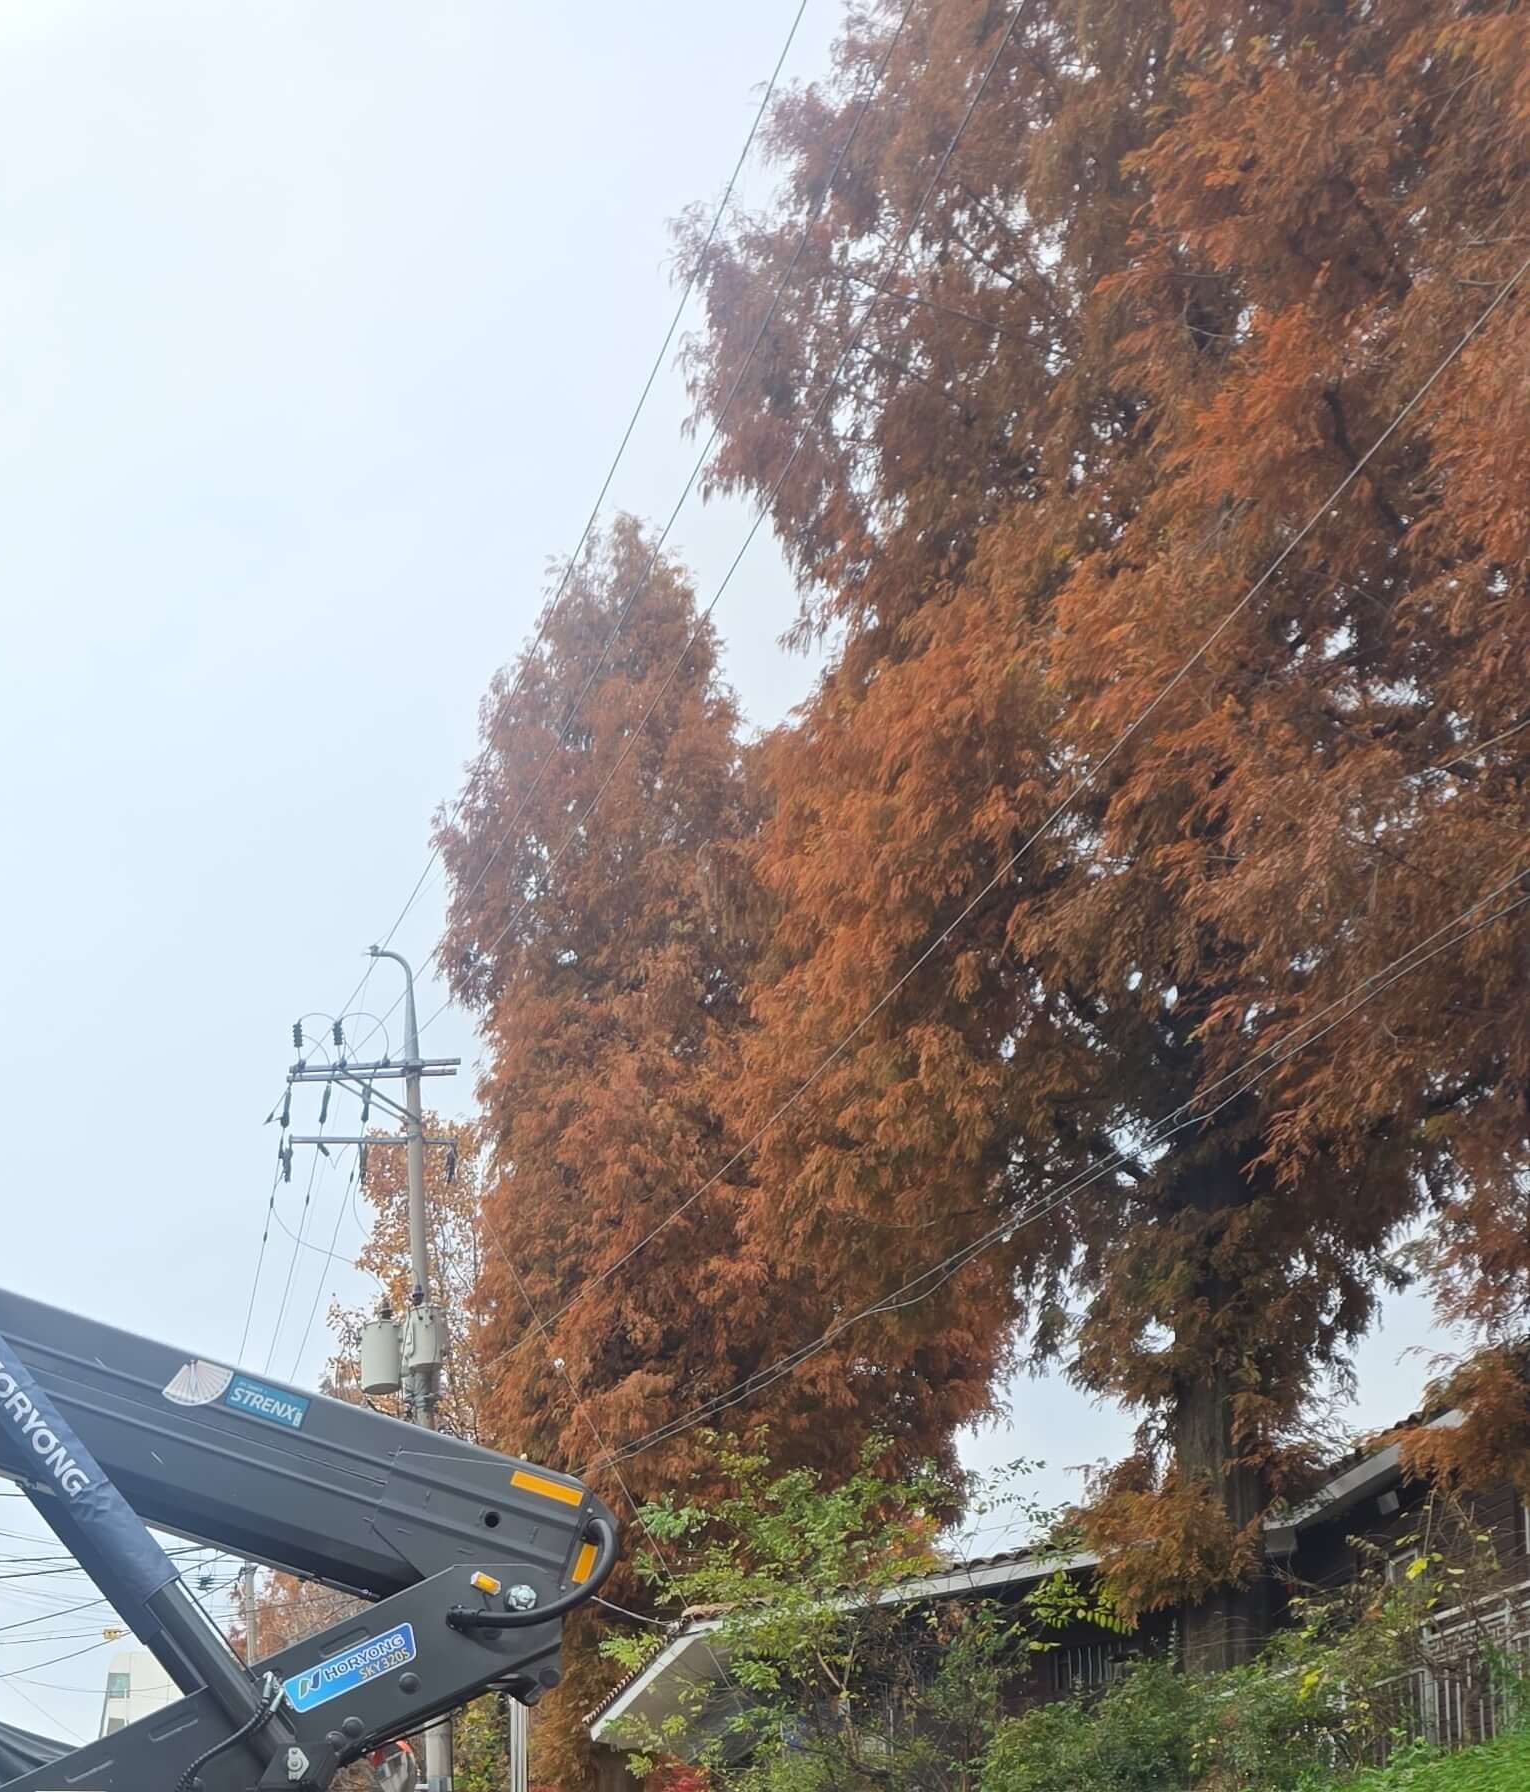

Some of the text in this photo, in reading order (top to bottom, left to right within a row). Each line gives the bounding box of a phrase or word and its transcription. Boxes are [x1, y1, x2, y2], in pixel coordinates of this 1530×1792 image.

[230, 1387, 298, 1421] STRENX
[323, 1633, 405, 1682] HORYONG
[359, 1661, 383, 1680] SKY
